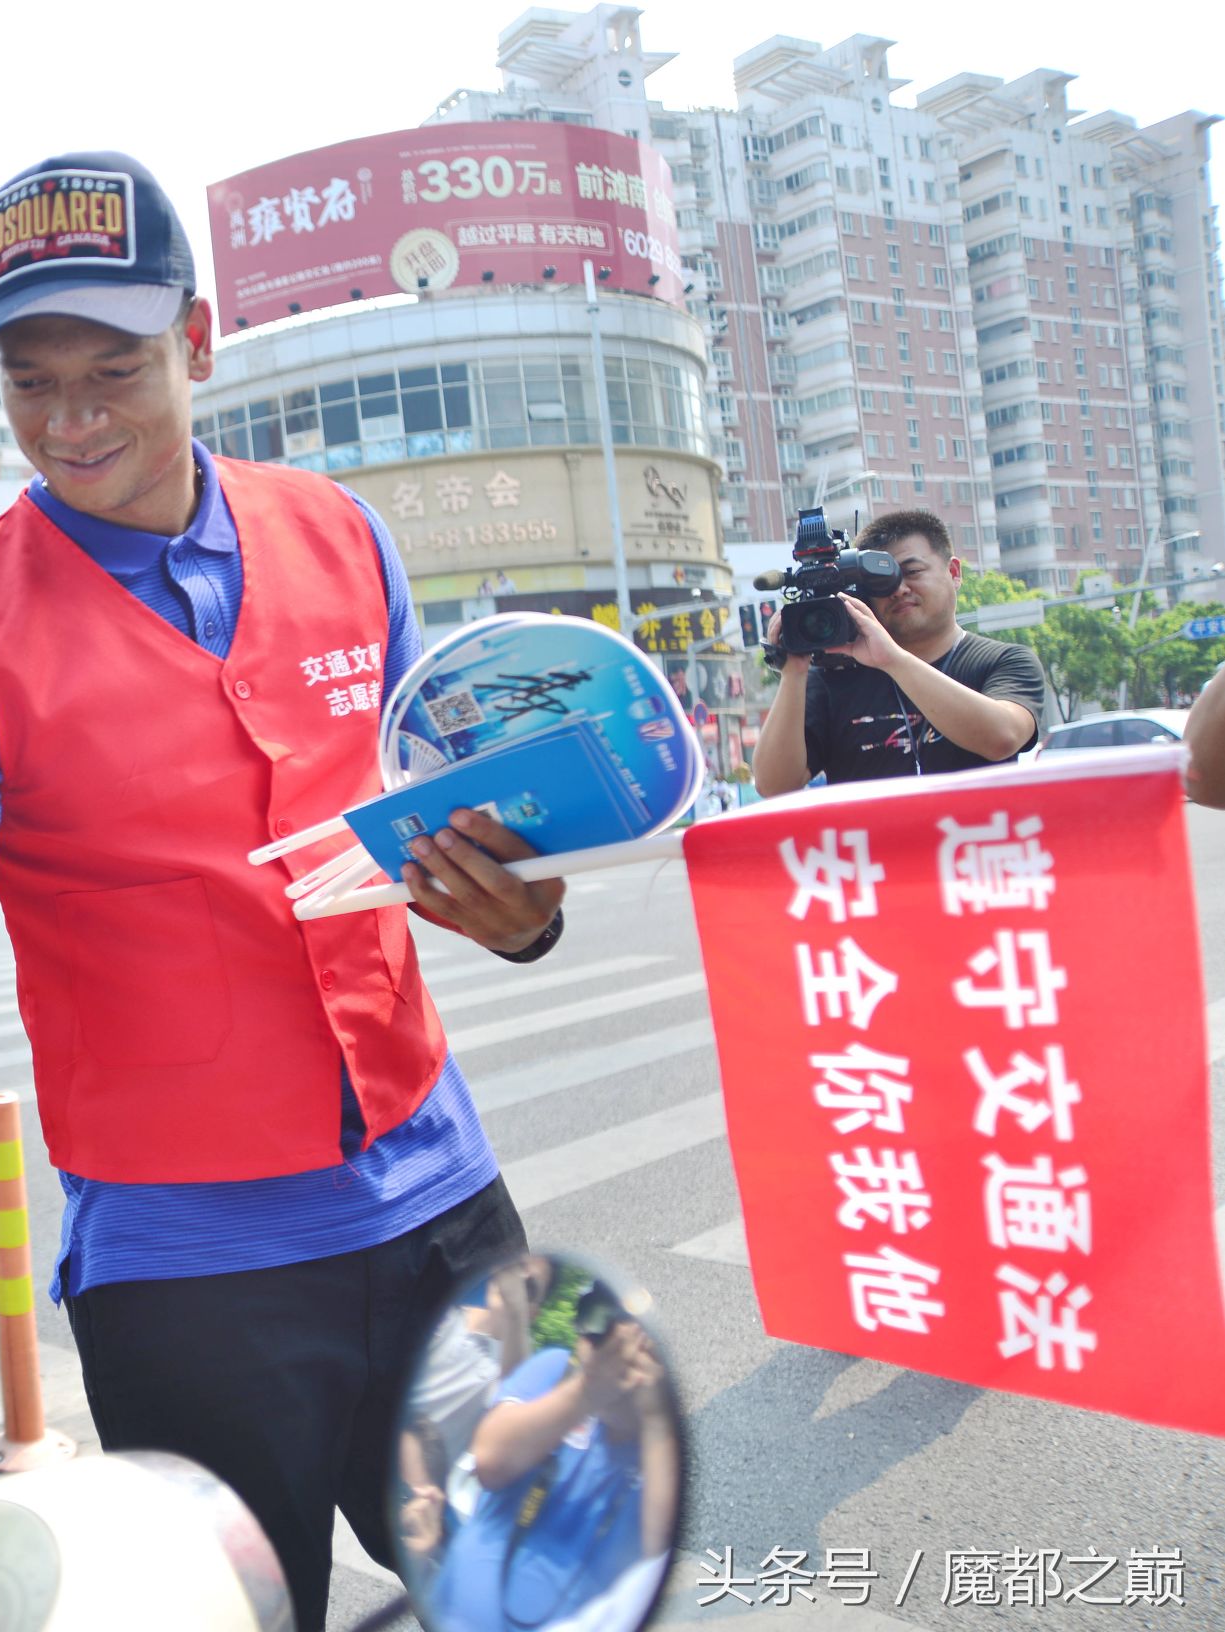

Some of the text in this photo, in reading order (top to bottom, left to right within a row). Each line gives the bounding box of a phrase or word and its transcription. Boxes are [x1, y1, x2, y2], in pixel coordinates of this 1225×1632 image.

[457, 223, 537, 247] 越过平层
[539, 223, 606, 249] 有天有地
[391, 469, 521, 520] 名帝会
[778, 826, 946, 1335] 安全你我他
[936, 810, 1098, 1373] 遵守交通法
